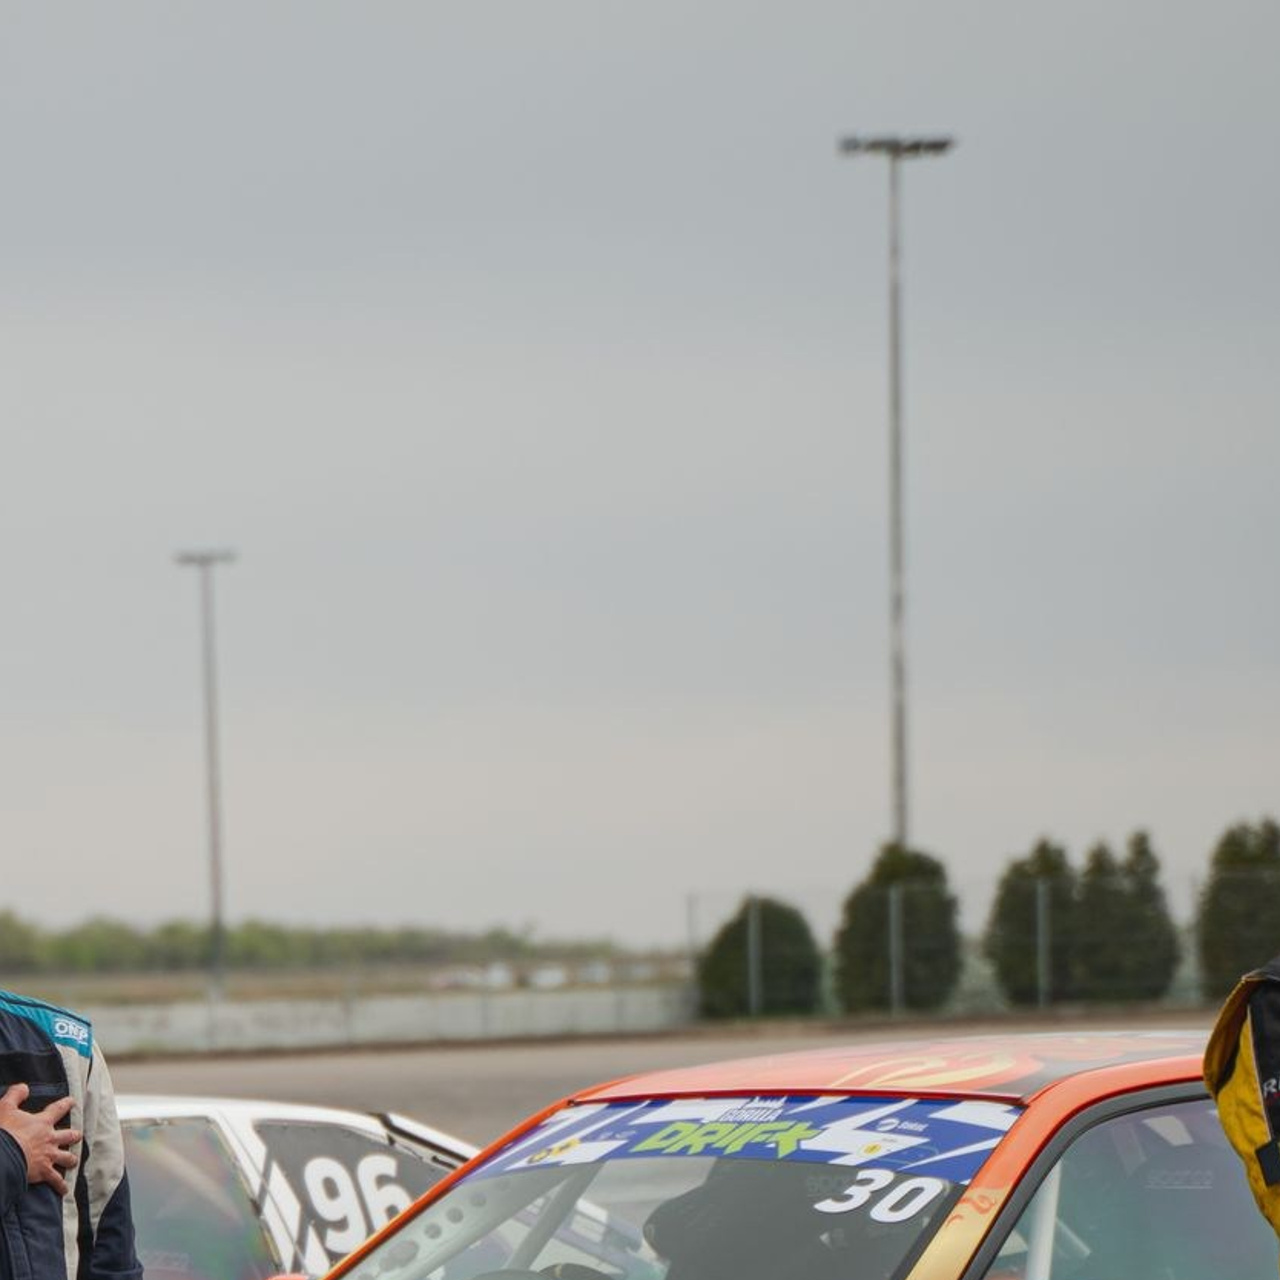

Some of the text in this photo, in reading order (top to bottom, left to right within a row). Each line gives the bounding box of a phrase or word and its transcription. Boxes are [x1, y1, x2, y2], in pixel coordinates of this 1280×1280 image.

[630, 1120, 822, 1159] DRIFT
[304, 1154, 416, 1254] 96
[813, 1168, 943, 1223] 30
